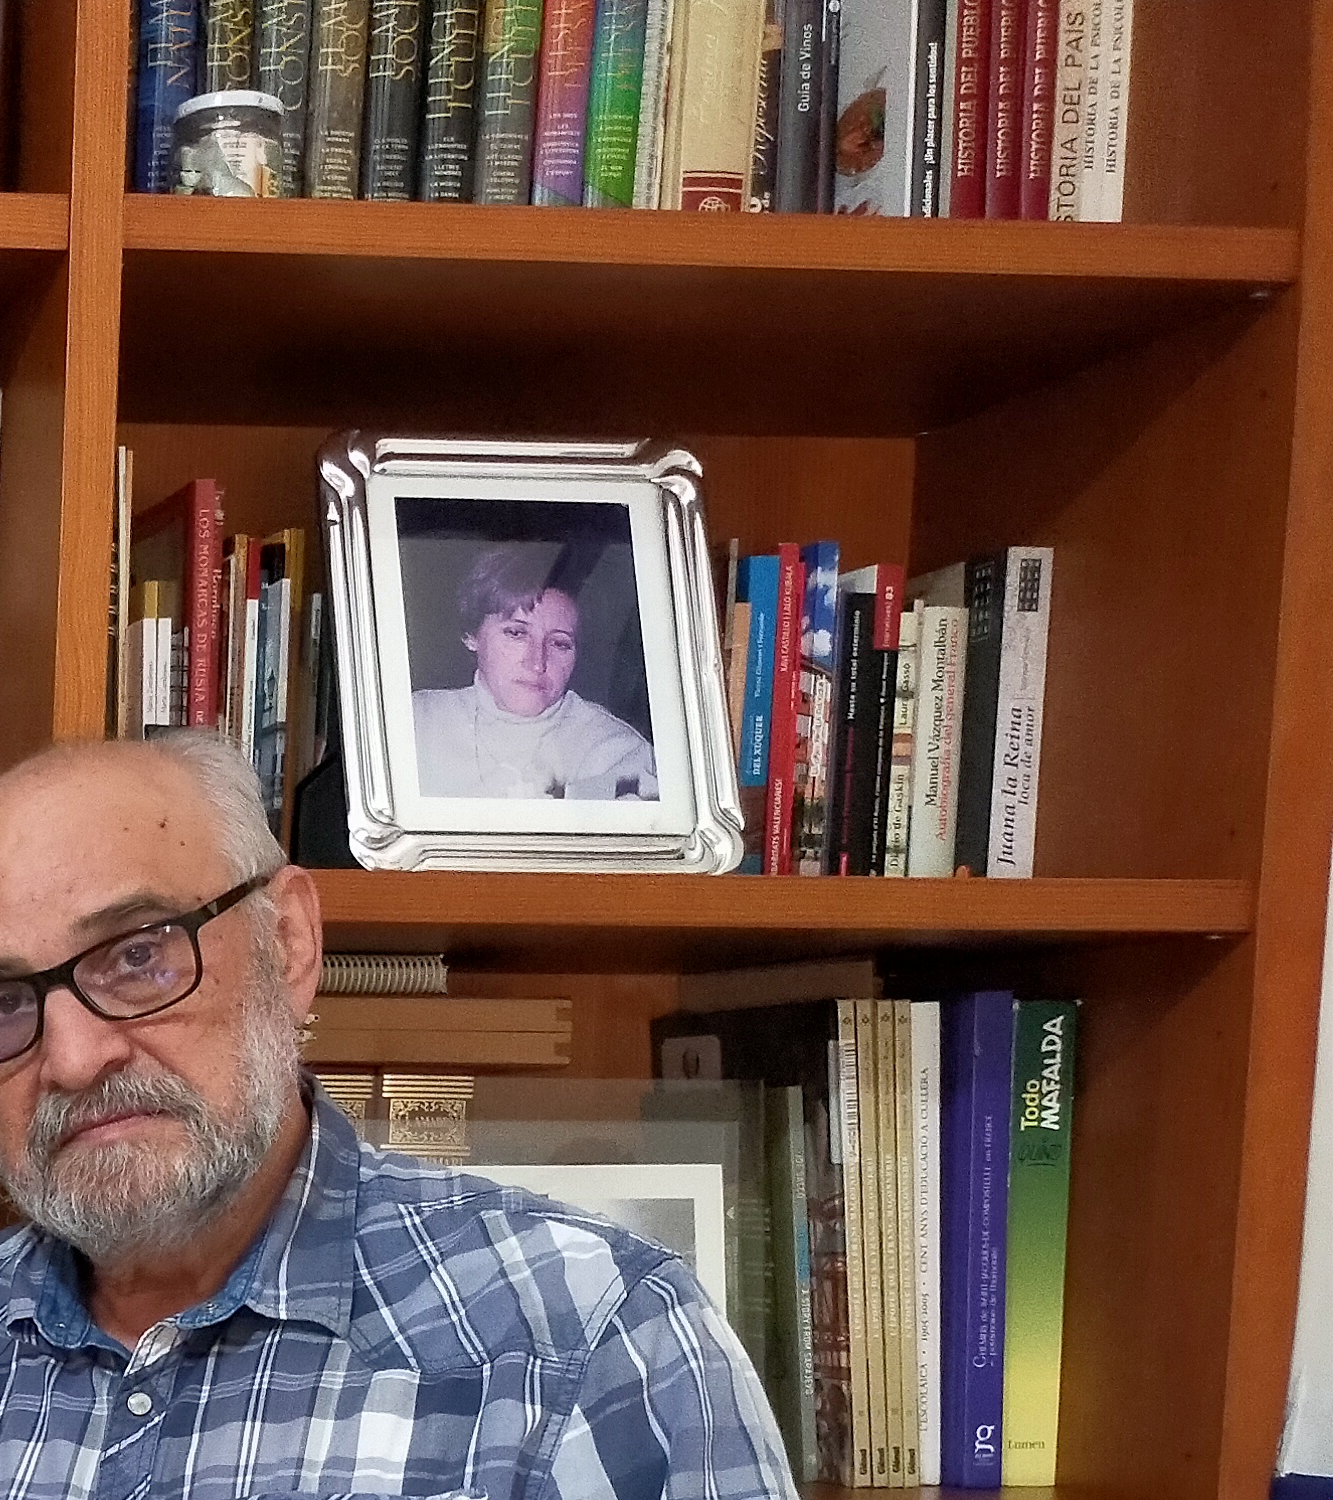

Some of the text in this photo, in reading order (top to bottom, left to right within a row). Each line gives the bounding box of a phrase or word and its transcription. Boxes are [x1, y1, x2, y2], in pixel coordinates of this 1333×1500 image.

[1061, 82, 1080, 124] DEL
[198, 507, 210, 538] LOS
[196, 544, 210, 628] MONARCAS
[195, 658, 207, 706] RUSIA
[924, 618, 948, 806] Manuel Vázquez Montalbán
[936, 618, 959, 841] Autobiografía del general Franco
[1019, 706, 1035, 805] loca de amor
[996, 707, 1022, 866] Juana la Reina
[920, 1068, 930, 1120] CULLERA
[1039, 1015, 1064, 1131] MAFALDA
[1021, 1079, 1040, 1131] Todo
[919, 1209, 929, 1240] ANYS
[919, 1243, 929, 1273] CENT
[1008, 1440, 1045, 1450] Lumen
